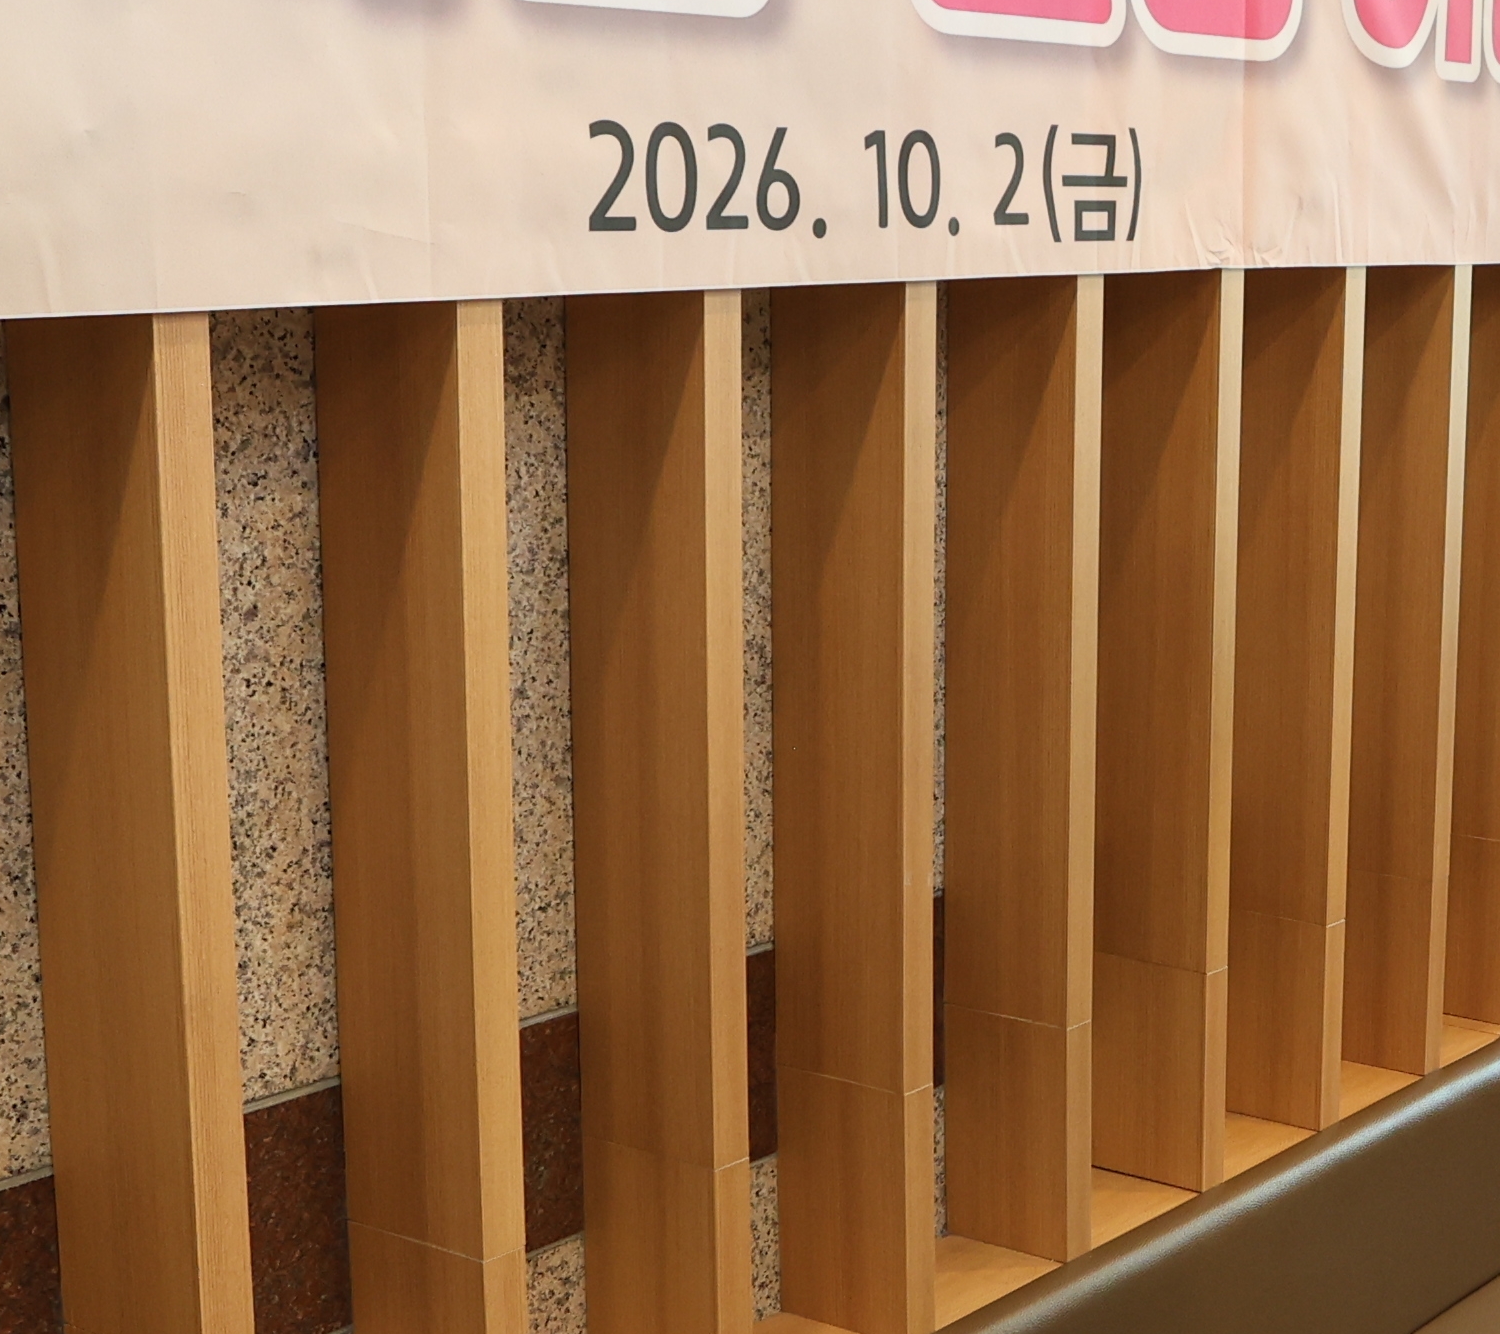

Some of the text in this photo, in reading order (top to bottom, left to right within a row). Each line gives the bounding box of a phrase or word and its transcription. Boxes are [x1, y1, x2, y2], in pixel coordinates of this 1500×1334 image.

[588, 119, 1143, 243] 2026. 10. 2(금)
